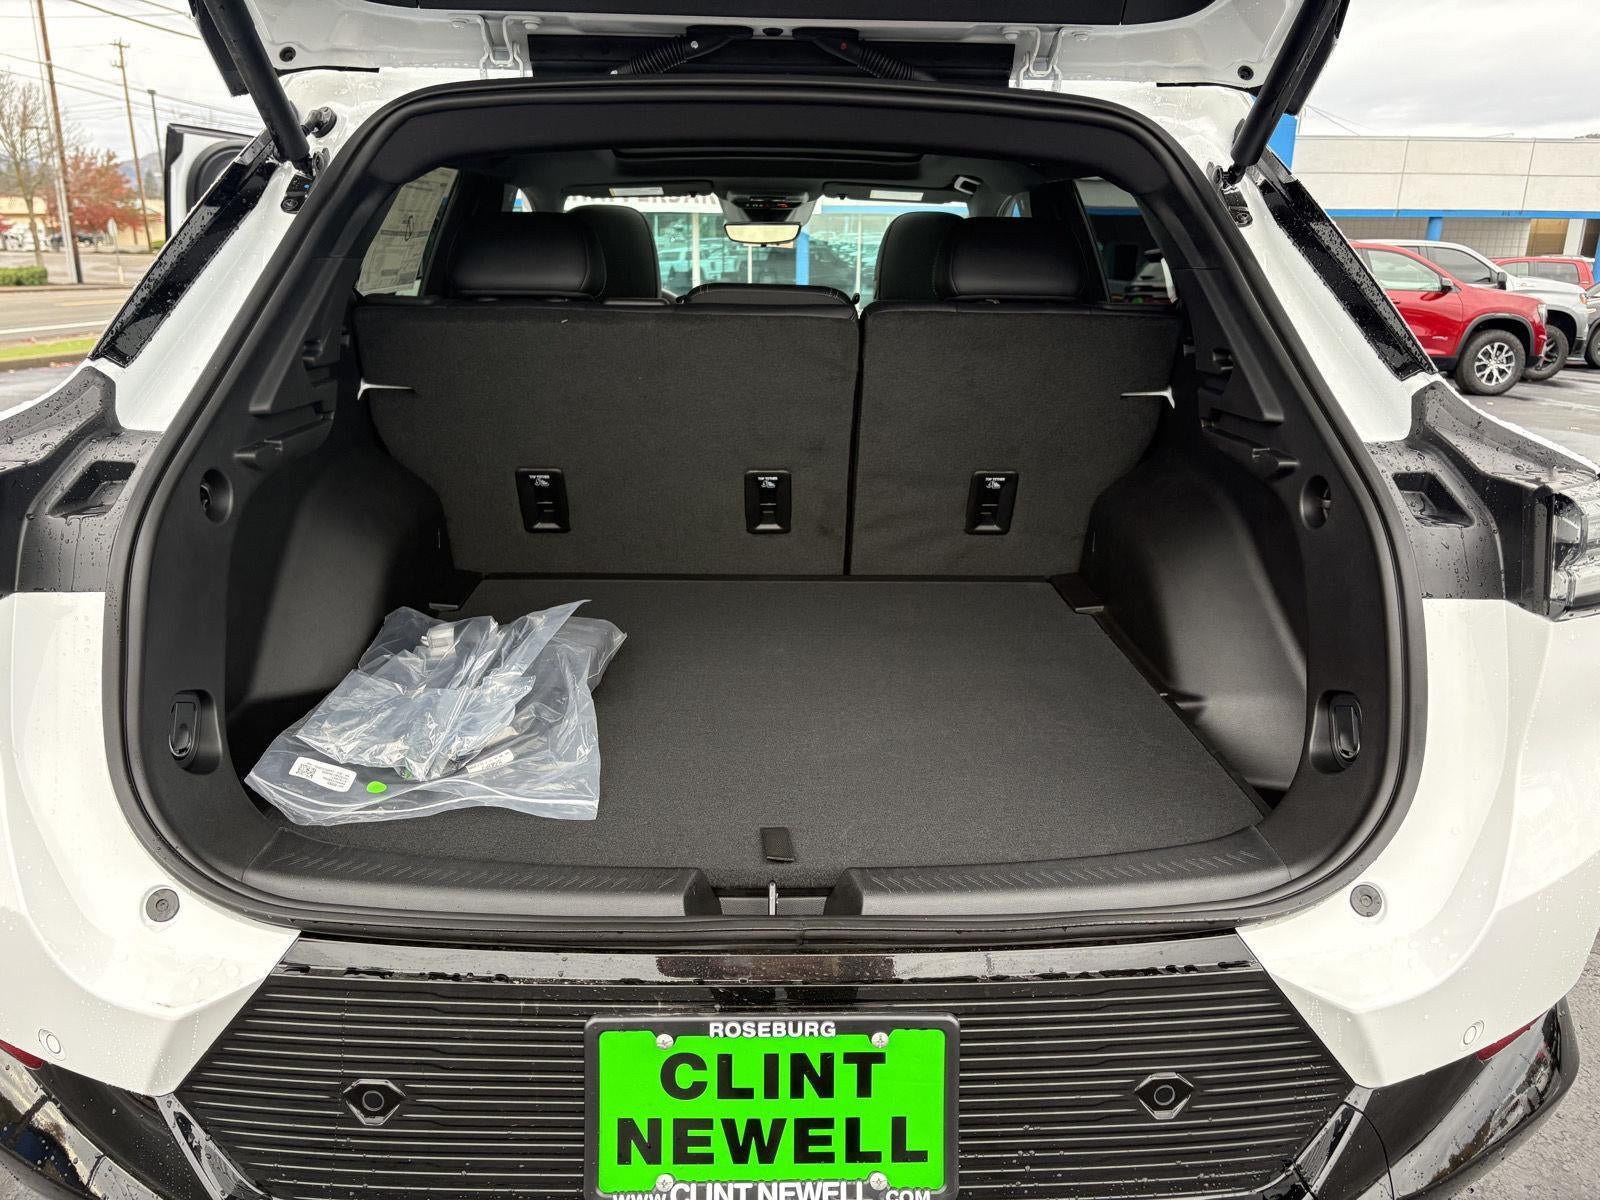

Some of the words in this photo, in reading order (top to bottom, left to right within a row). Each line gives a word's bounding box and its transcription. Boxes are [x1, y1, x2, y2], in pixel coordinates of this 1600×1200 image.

[709, 1021, 836, 1038] ROSEBURG
[660, 1051, 886, 1101] CLINT
[616, 1116, 929, 1166] NEWELL
